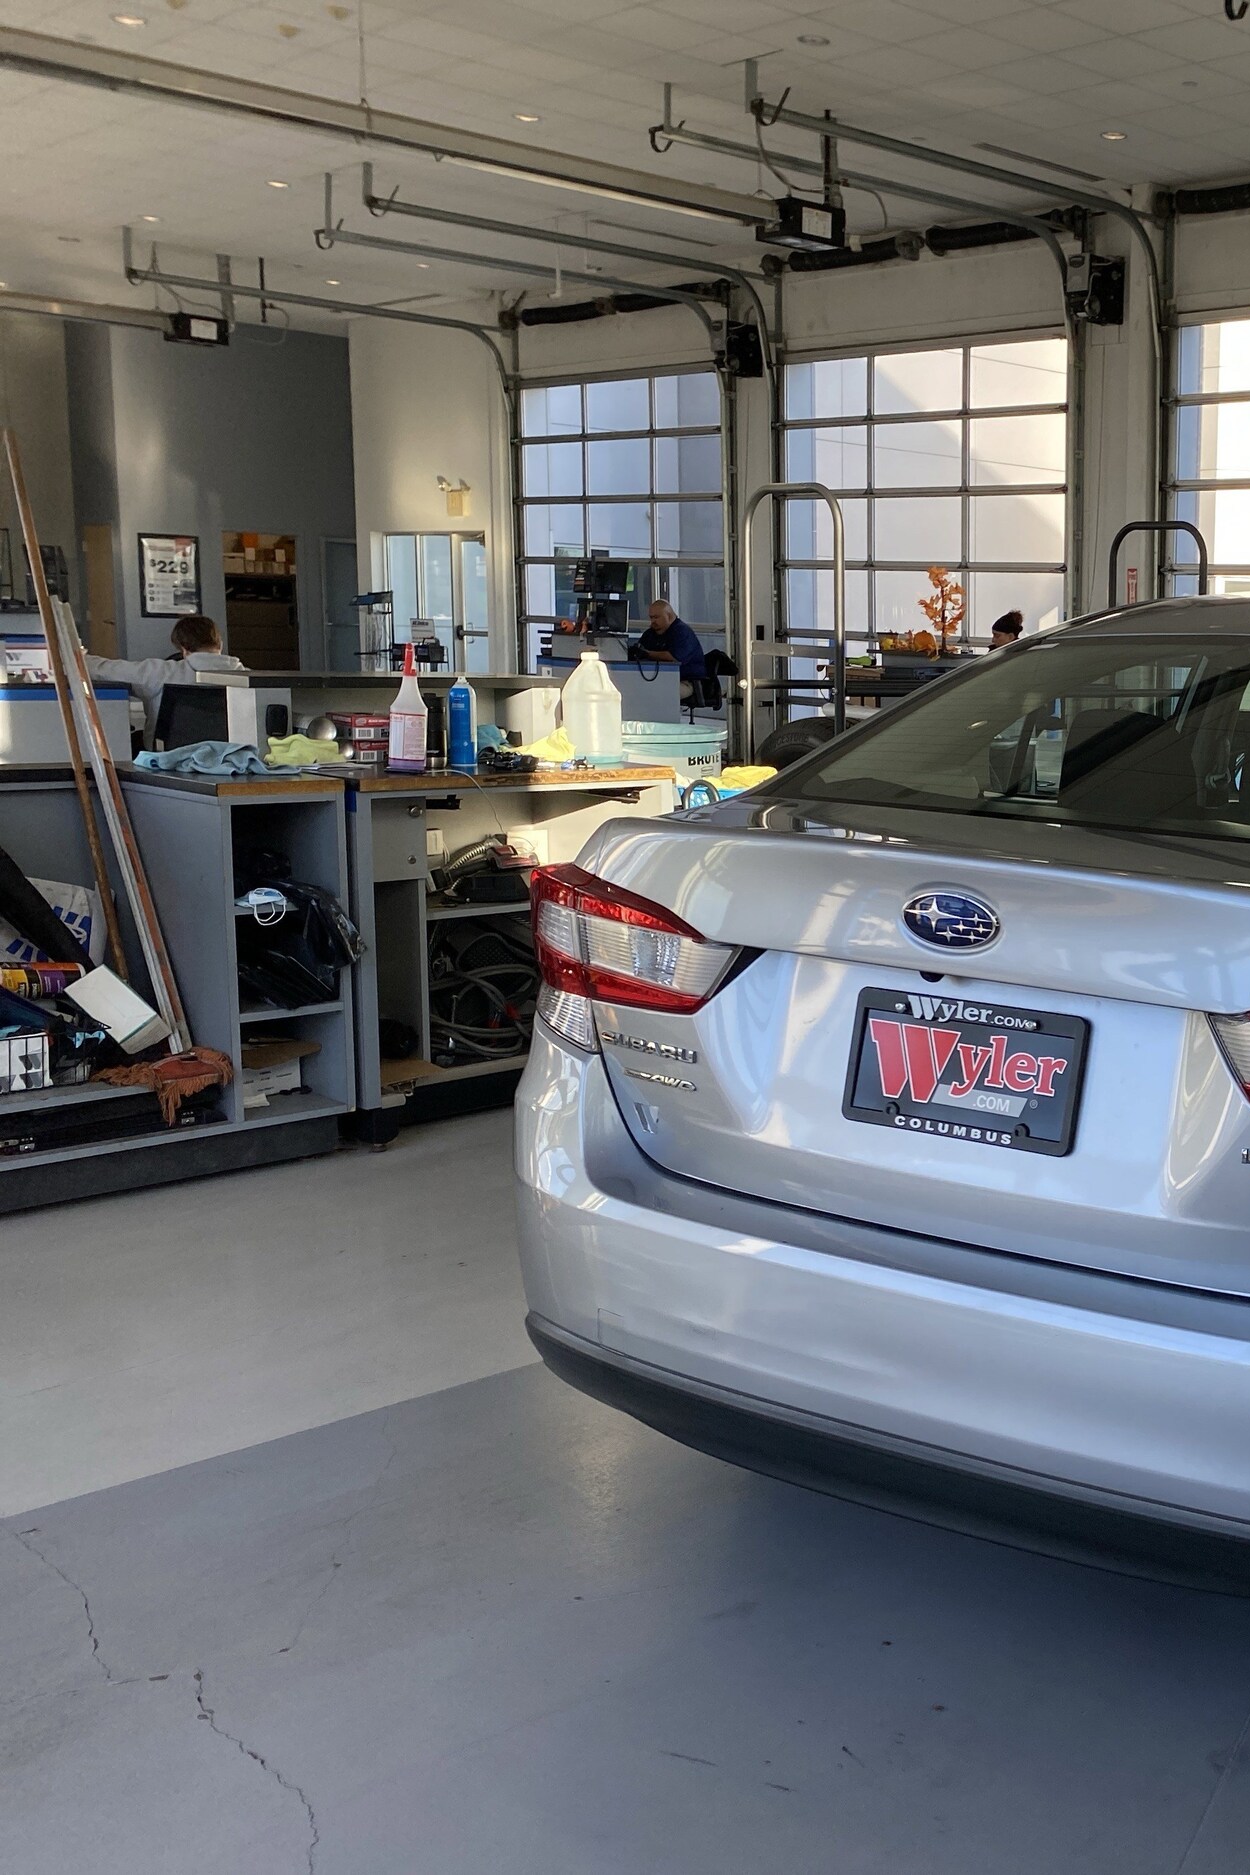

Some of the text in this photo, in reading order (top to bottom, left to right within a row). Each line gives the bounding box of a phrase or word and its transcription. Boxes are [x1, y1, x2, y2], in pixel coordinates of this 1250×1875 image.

[687, 753, 719, 766] BRUTE
[601, 1030, 698, 1064] SUBARU
[869, 1018, 1067, 1103] Wyler
[649, 1073, 697, 1091] AWD
[894, 1115, 1013, 1146] COLUMBUS
